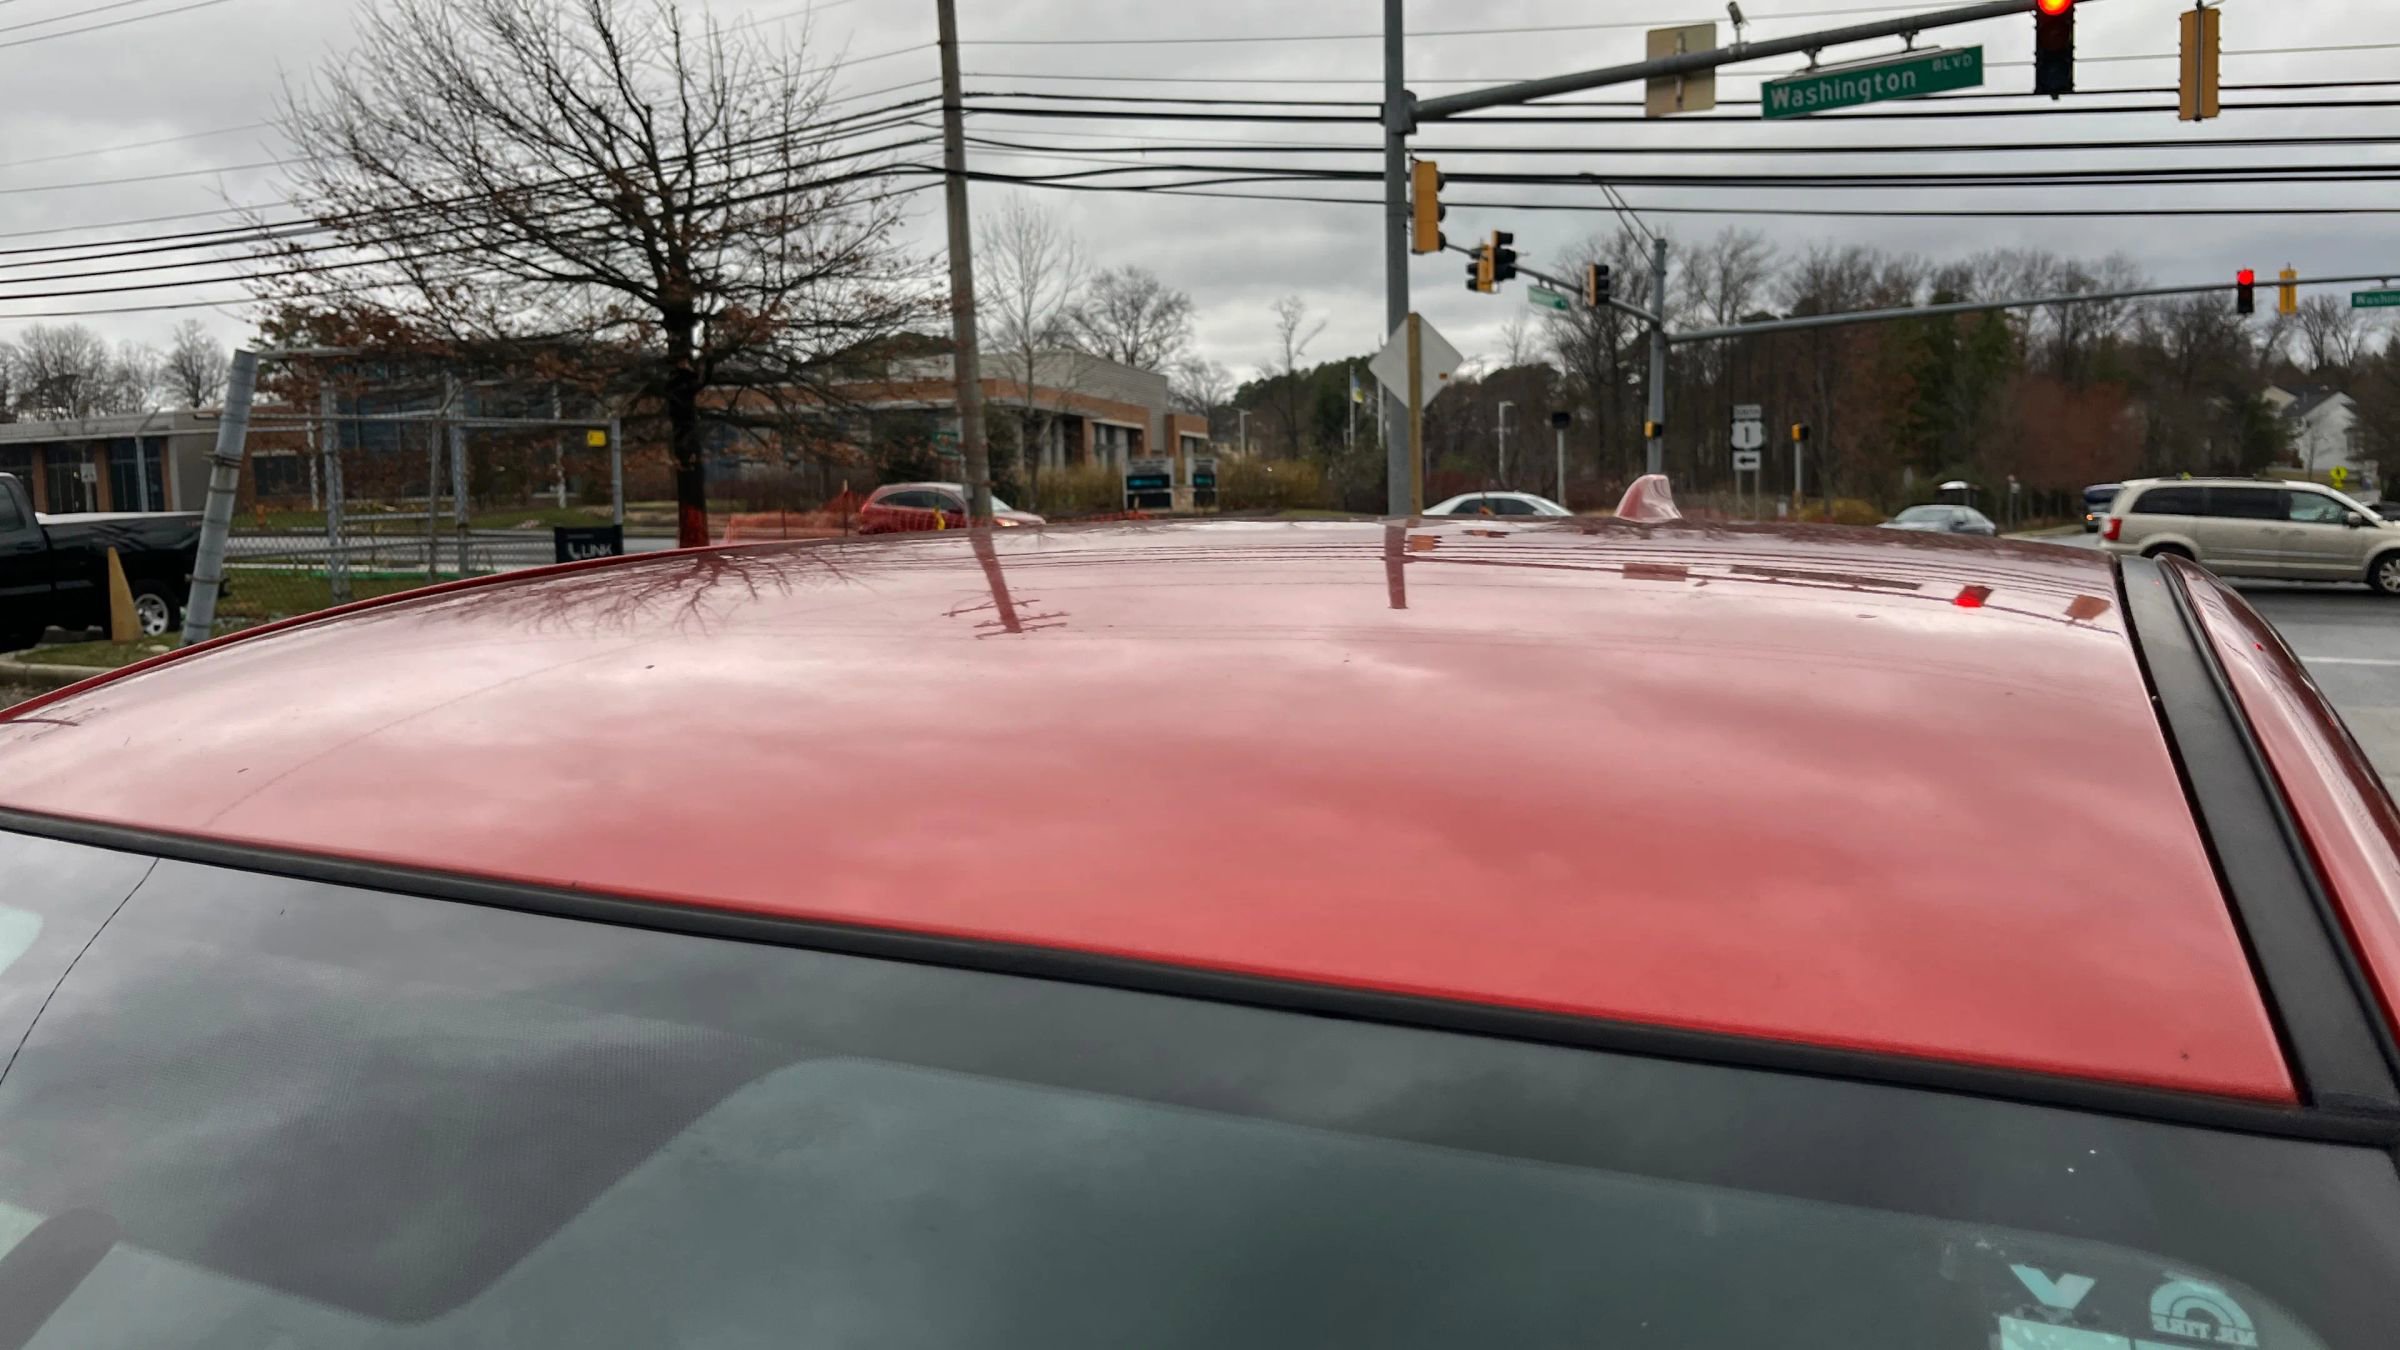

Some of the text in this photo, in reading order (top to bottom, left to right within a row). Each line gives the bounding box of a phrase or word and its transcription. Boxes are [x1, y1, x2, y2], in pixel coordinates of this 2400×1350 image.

[1771, 53, 1973, 110] Washington BLVD
[1744, 426, 1750, 443] 1
